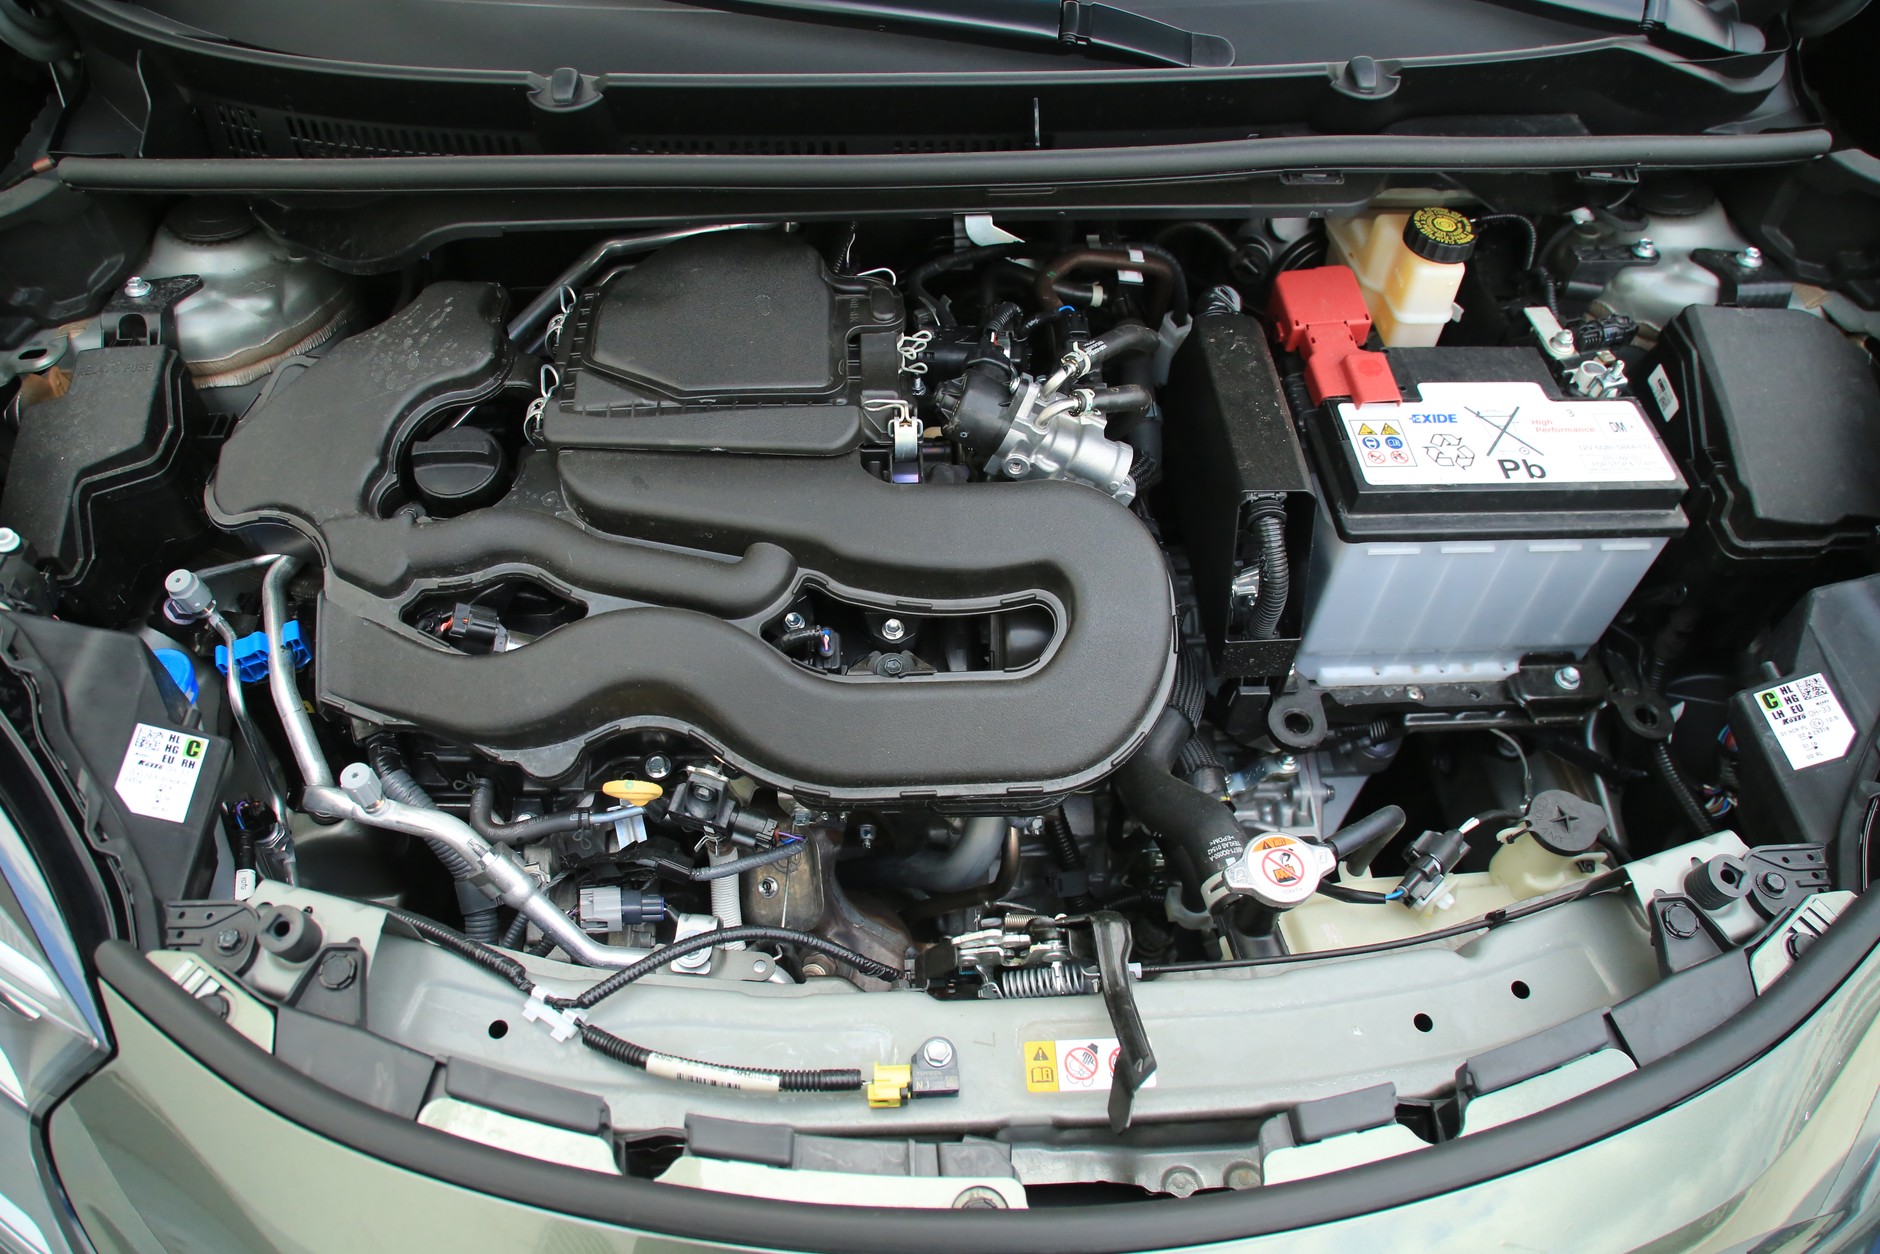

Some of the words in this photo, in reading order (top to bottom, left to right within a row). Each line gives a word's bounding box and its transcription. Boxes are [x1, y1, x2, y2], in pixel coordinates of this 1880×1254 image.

[1409, 413, 1458, 424] EXIDE
[1535, 426, 1596, 434] Performance
[1497, 459, 1547, 479] Pb
[1779, 685, 1793, 696] HL
[1761, 692, 1779, 710] C
[1783, 694, 1800, 706] HG
[1771, 710, 1785, 720] LH
[1790, 704, 1804, 715] EU
[168, 734, 180, 744] HL
[164, 744, 180, 755] HG
[185, 739, 202, 757] C
[161, 754, 175, 765] EU
[181, 759, 197, 769] RH
[1535, 797, 1566, 842] COOLANT
